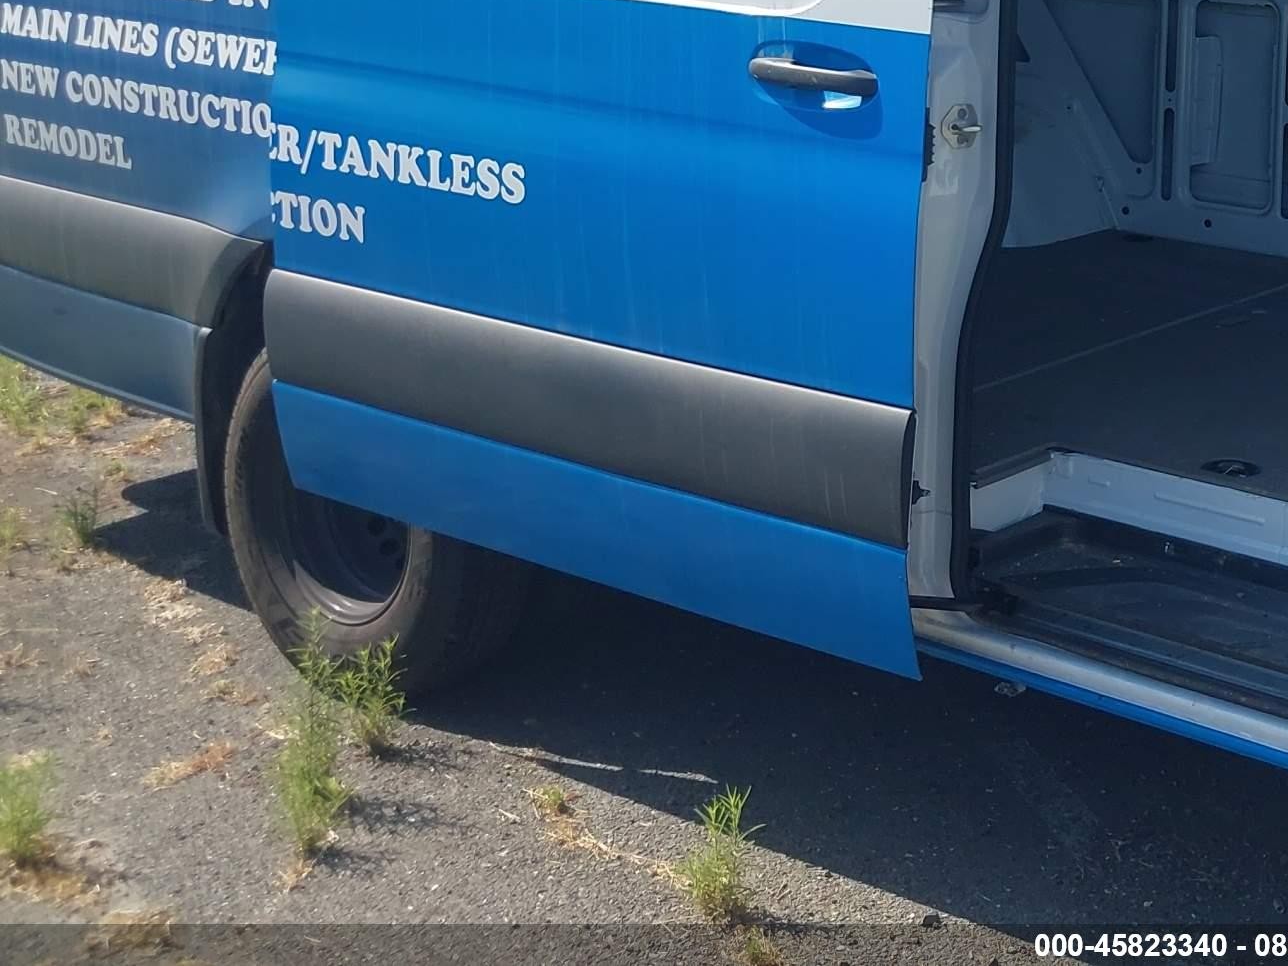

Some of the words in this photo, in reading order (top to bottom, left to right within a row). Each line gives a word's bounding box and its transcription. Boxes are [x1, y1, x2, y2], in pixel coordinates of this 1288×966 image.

[1, 3, 72, 43] MAIN
[75, 13, 158, 57] LINES
[1, 59, 60, 99] NEW
[4, 113, 132, 170] REMODEL
[271, 190, 366, 244] TION
